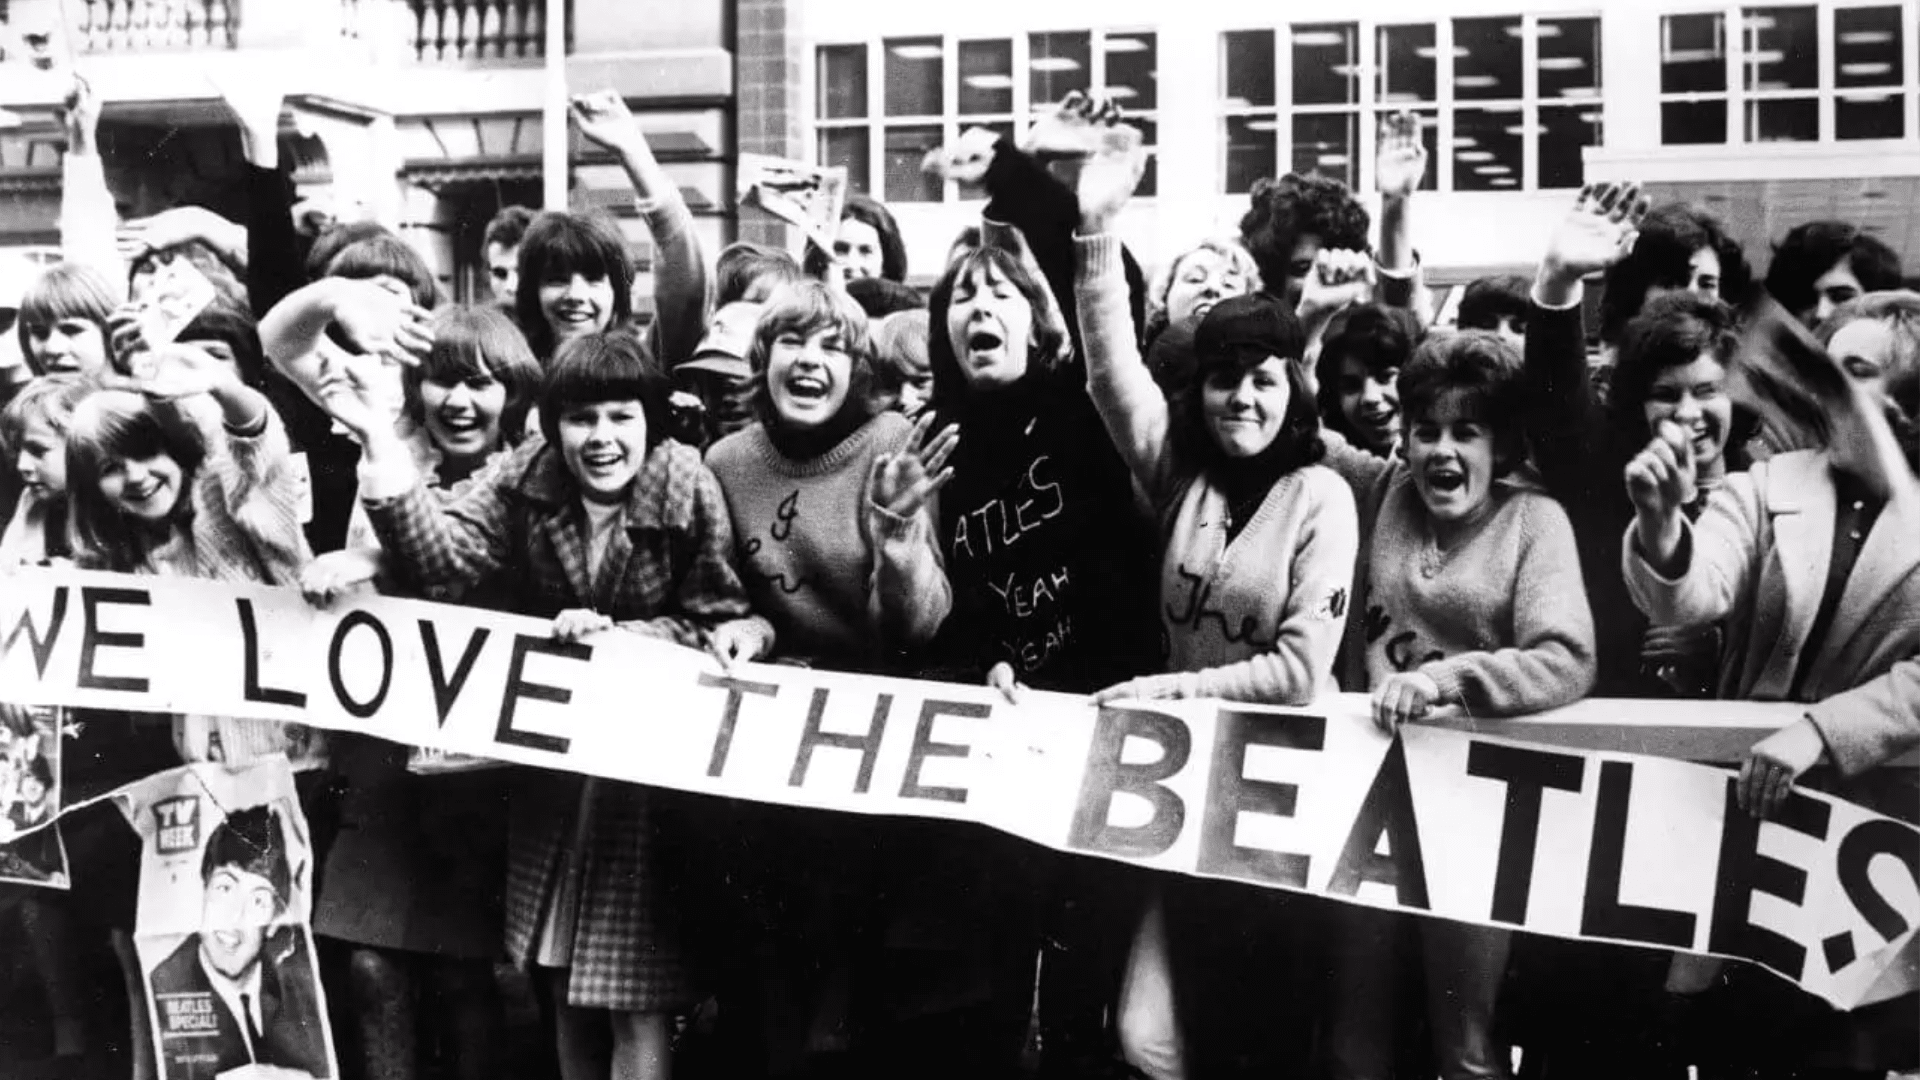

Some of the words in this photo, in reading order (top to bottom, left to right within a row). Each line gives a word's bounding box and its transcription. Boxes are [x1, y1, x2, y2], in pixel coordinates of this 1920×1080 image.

[987, 566, 1069, 617] YEAH
[1001, 616, 1071, 671] YEAH
[0, 586, 152, 692] WE
[236, 597, 593, 754] LOVE
[697, 671, 992, 803] THE
[1067, 705, 1920, 983] BEATLES
[156, 800, 197, 826] TV
